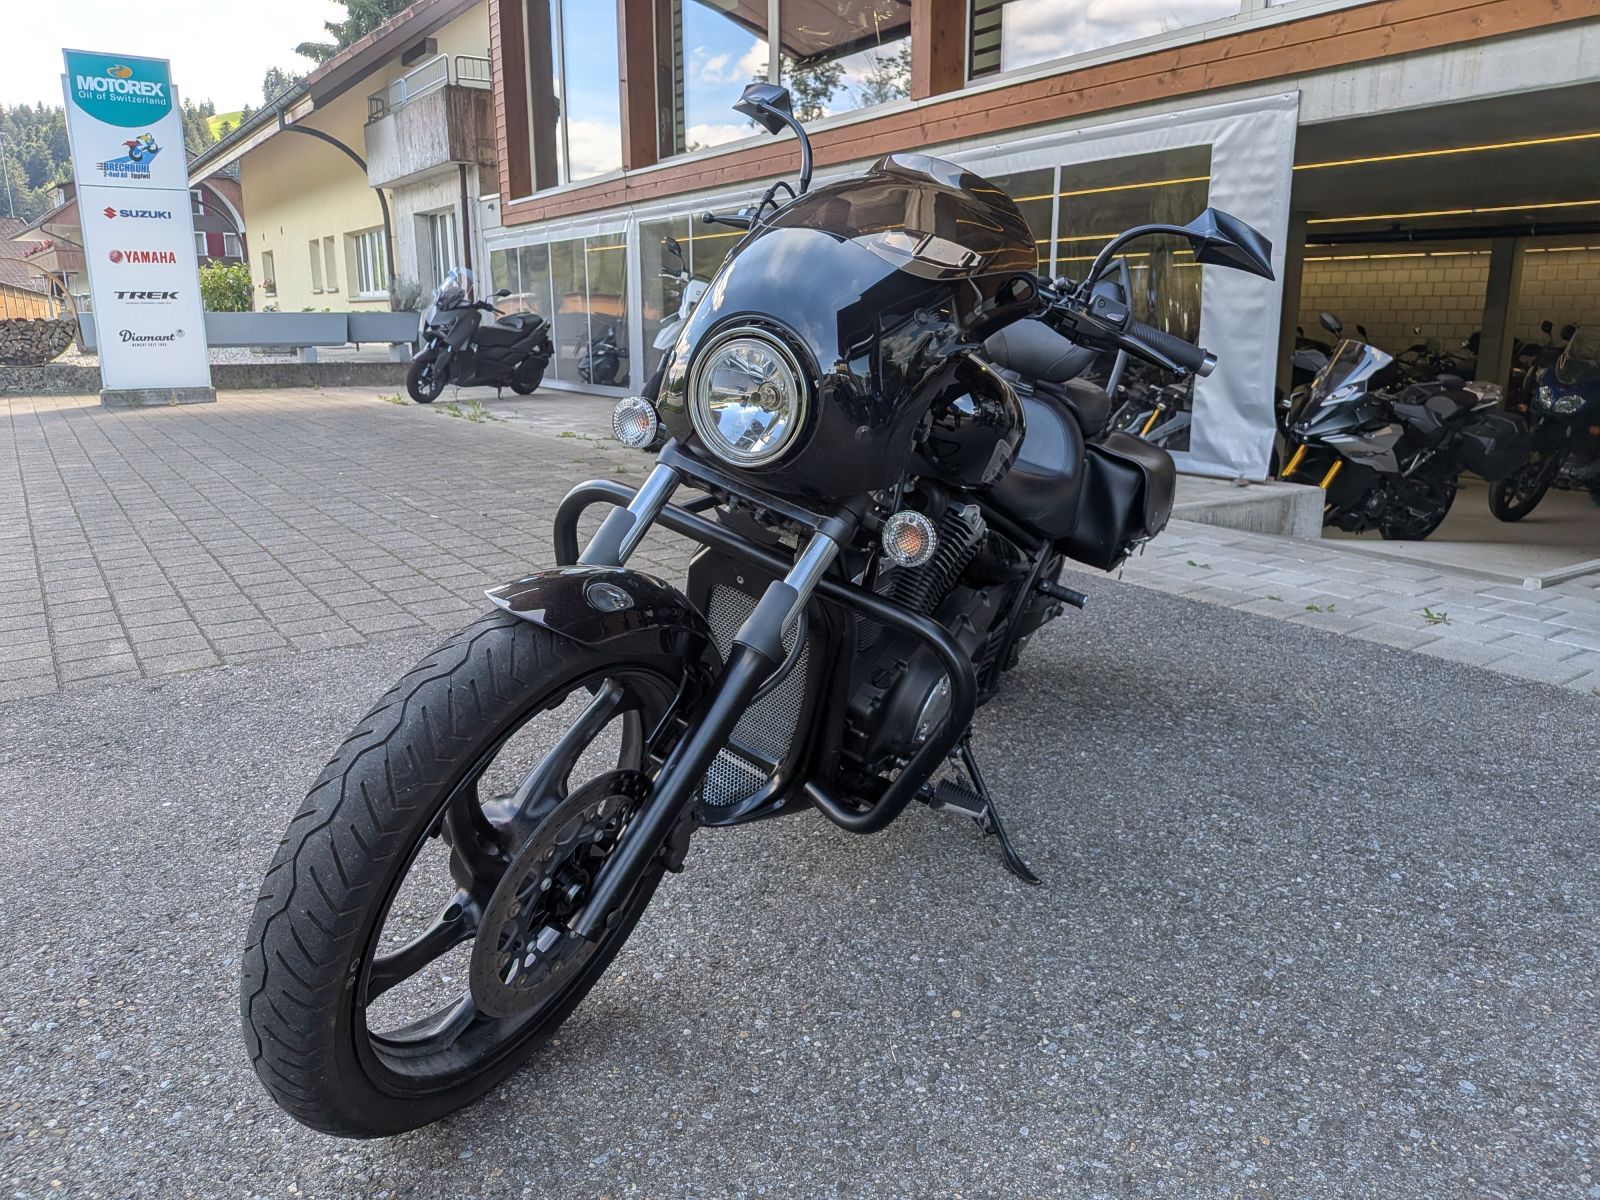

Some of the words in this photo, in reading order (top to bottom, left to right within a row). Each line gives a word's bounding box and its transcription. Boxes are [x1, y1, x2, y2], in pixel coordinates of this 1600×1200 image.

[76, 75, 165, 97] MOTOREX
[78, 91, 93, 99] Oil
[109, 94, 167, 105] Switzerland
[119, 209, 172, 219] SUZUKI
[123, 250, 177, 264] YAMAHA
[113, 291, 180, 300] TREK
[119, 329, 176, 343] Diamant
